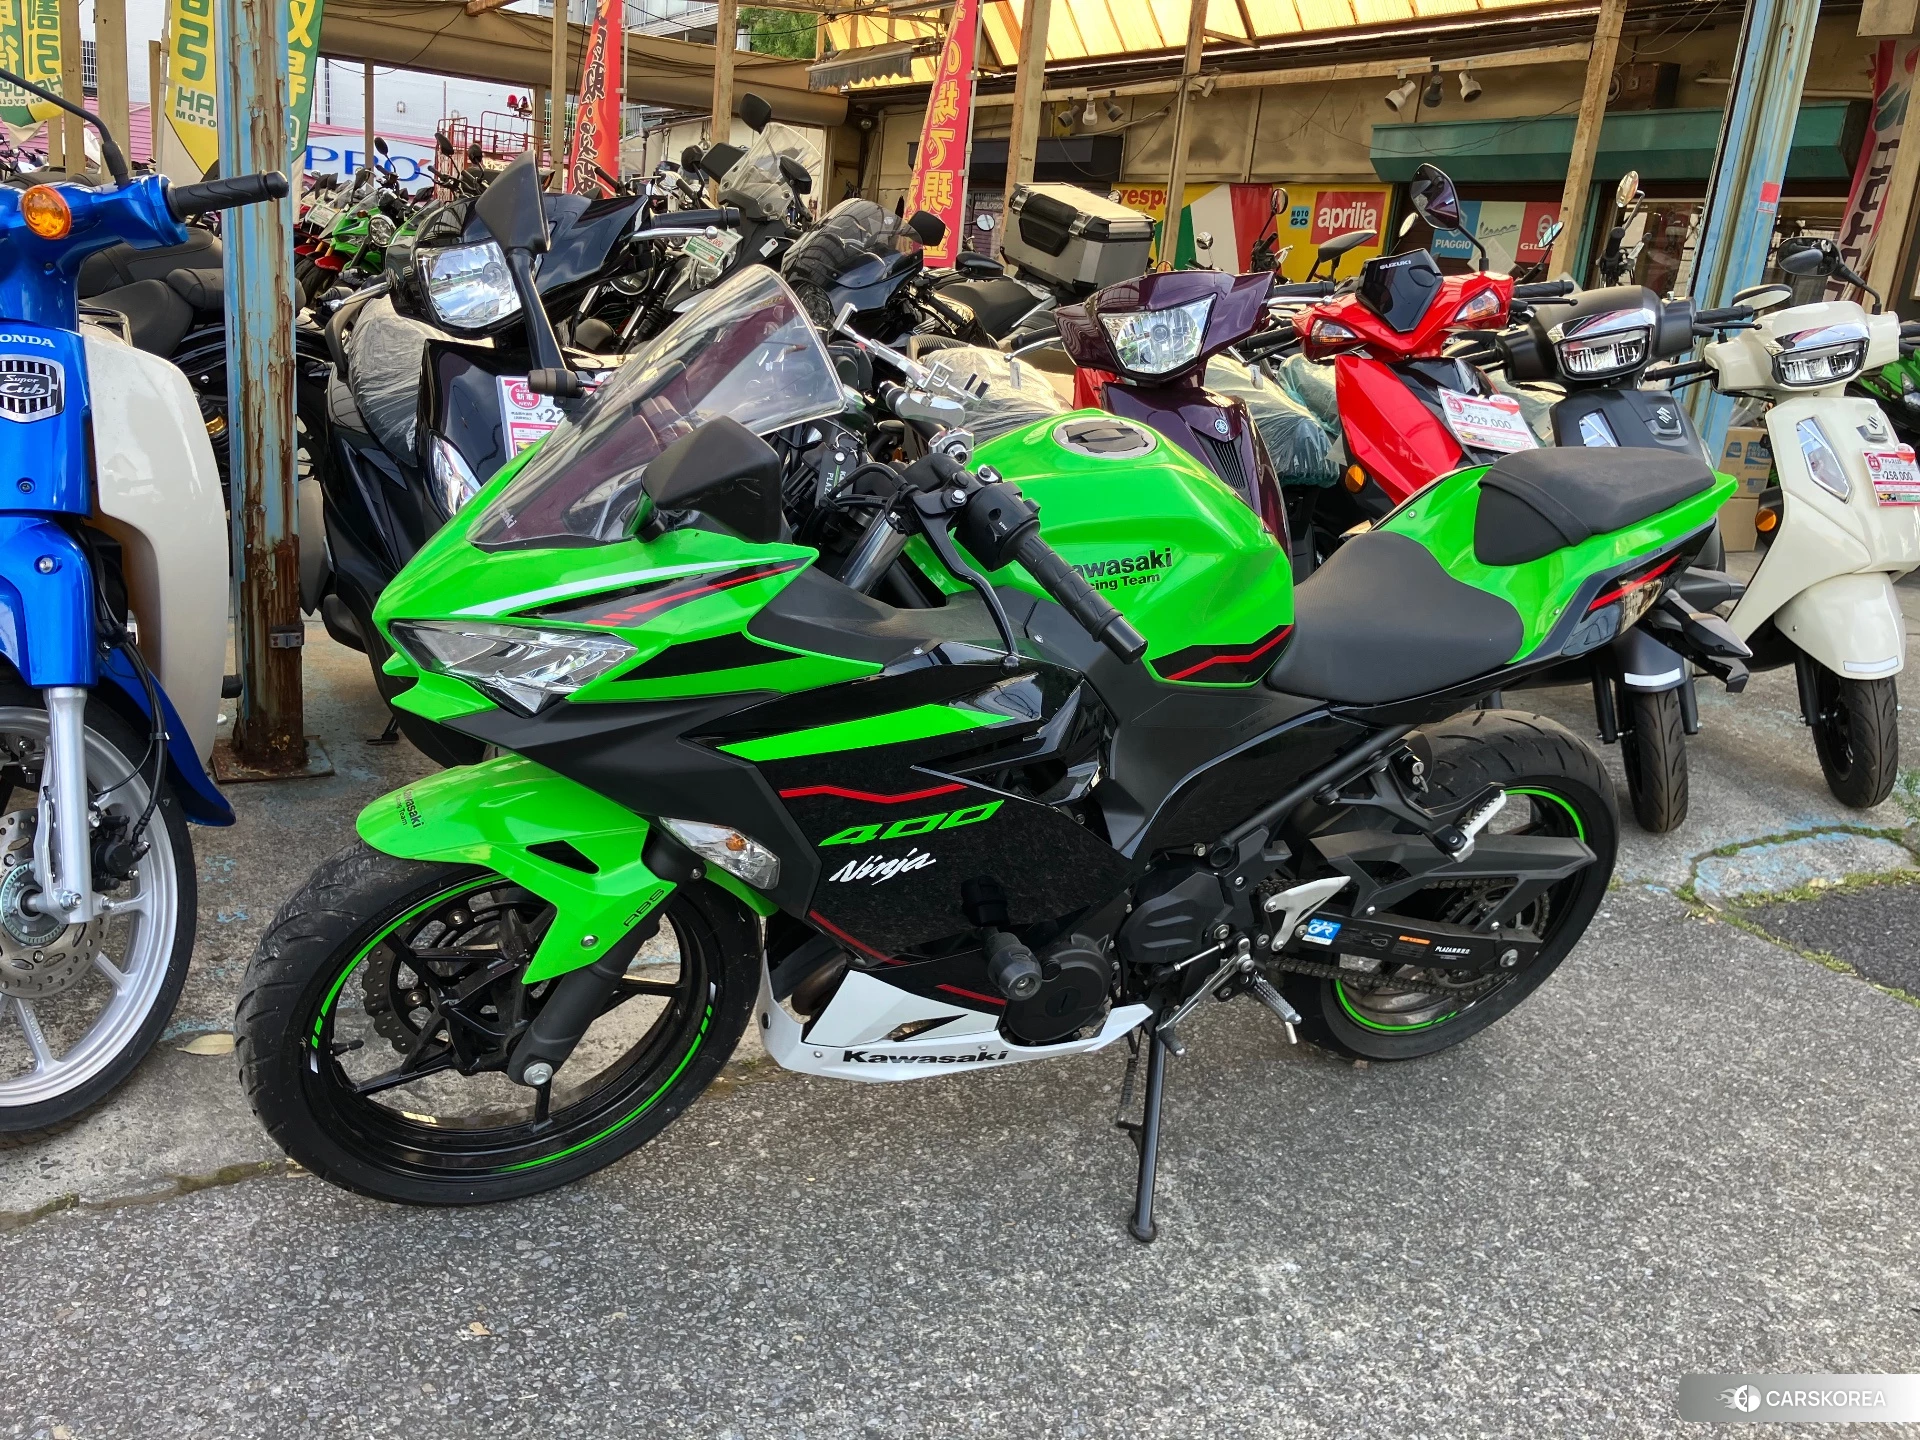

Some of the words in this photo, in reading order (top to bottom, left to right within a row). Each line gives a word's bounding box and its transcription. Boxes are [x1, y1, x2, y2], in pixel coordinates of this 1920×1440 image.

[175, 109, 217, 129] MOTO
[1290, 217, 1309, 226] GO
[1291, 210, 1309, 218] MOTO
[1317, 201, 1377, 234] aprilia
[1435, 239, 1472, 250] PIAGGIO
[1379, 259, 1412, 270] SUZUKI
[0, 333, 56, 348] ONDA
[3, 374, 40, 384] Super
[0, 382, 46, 395] Cub
[823, 472, 835, 495] PLAZ
[1073, 547, 1173, 579] awasaki
[1121, 576, 1161, 587] Team
[819, 799, 1005, 847] 400
[828, 847, 937, 886] Ninja
[623, 887, 666, 928] ABS
[842, 1049, 1008, 1065] Kawasaki
